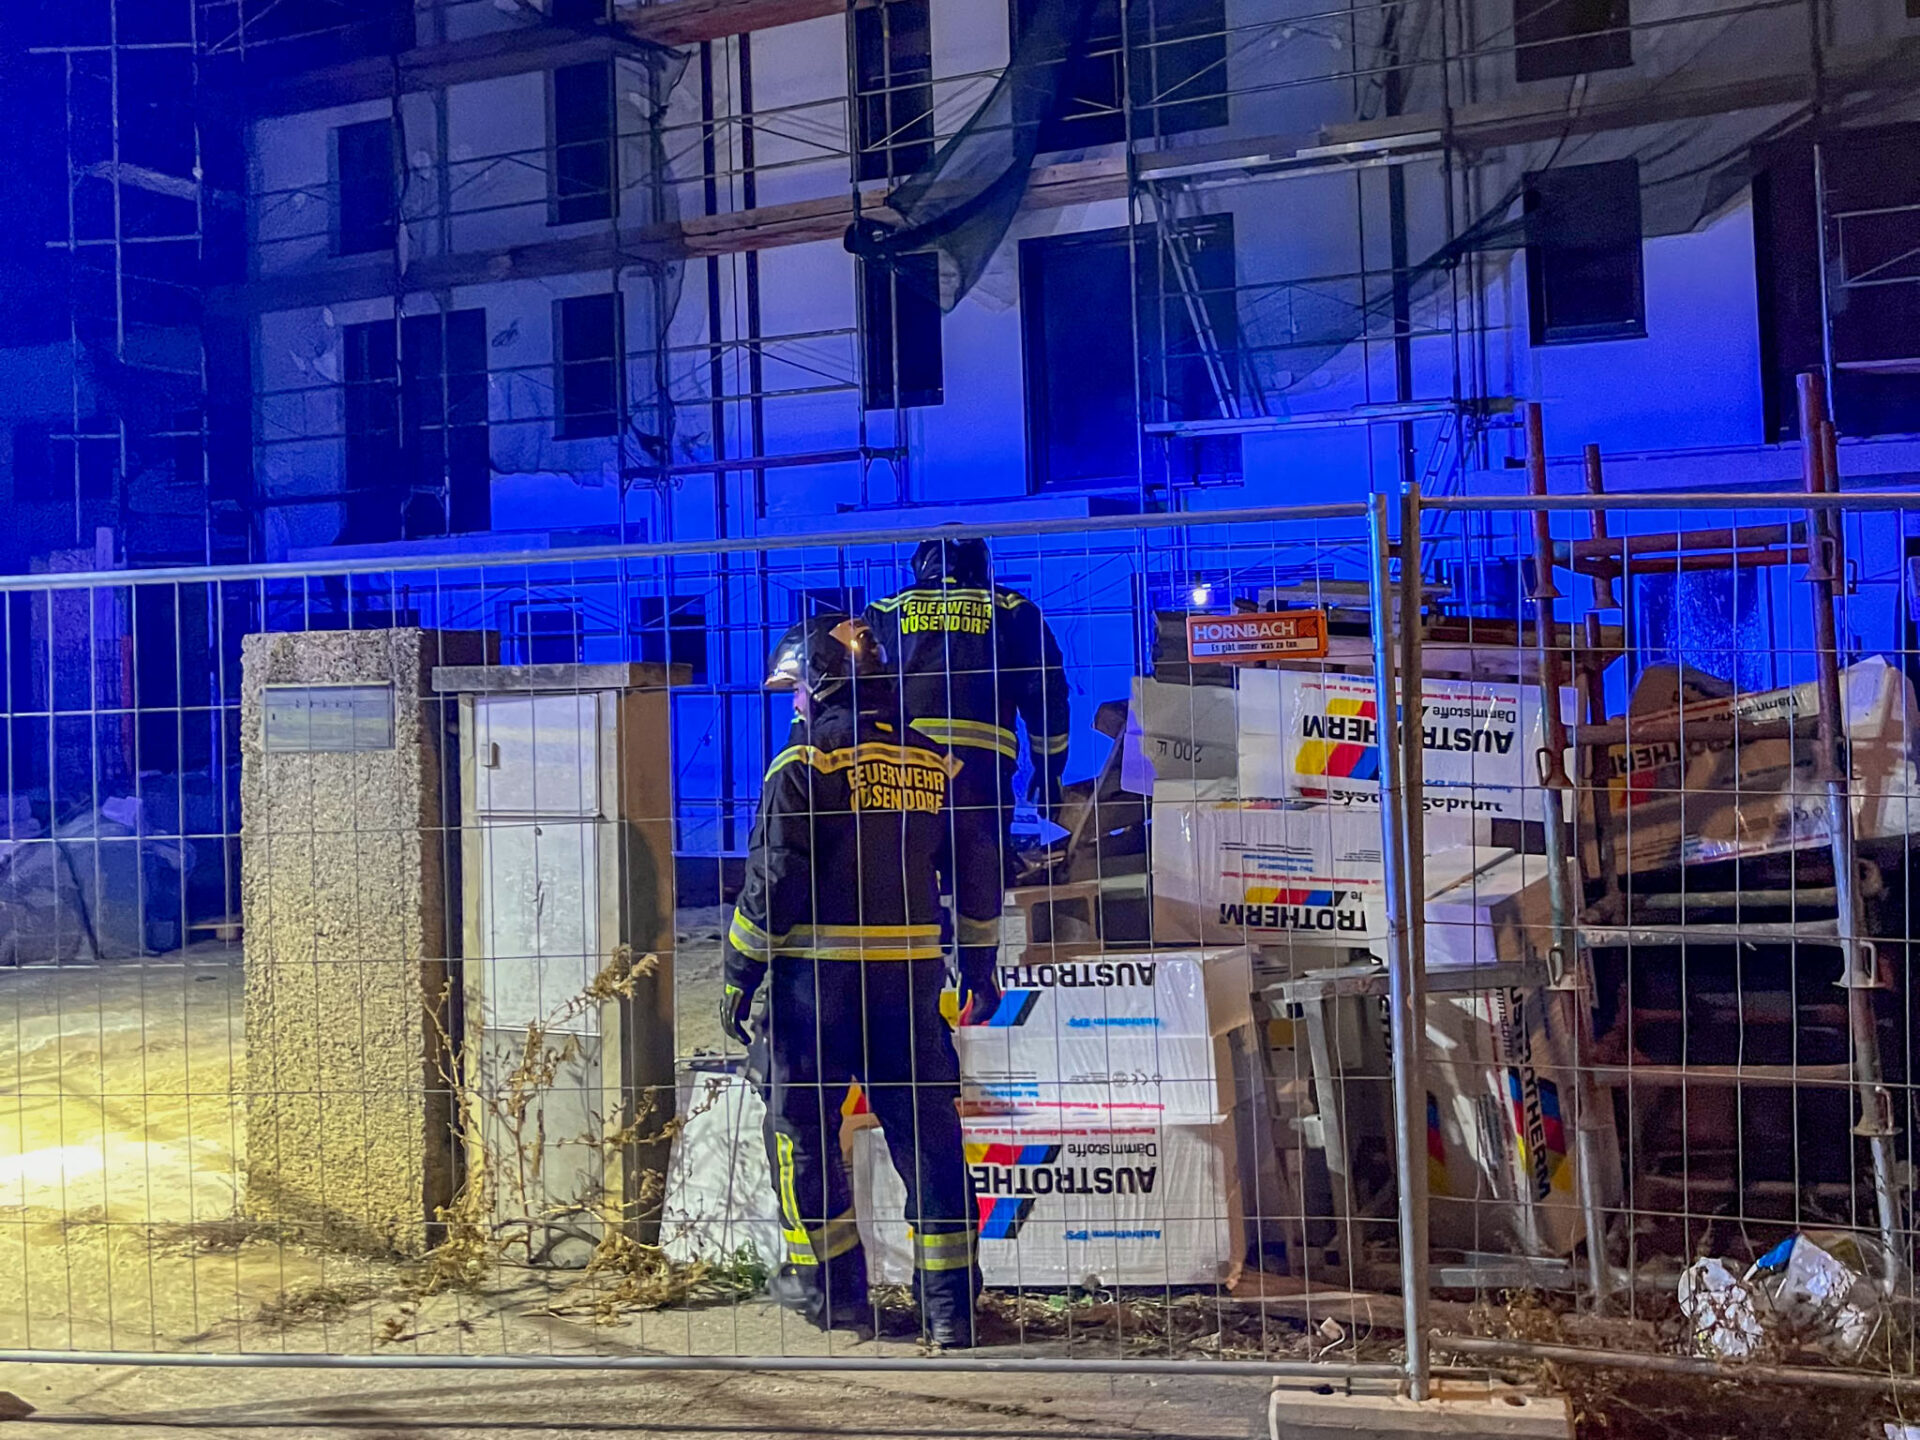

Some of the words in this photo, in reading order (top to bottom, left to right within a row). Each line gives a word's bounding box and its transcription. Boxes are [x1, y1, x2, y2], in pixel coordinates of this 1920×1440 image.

[1194, 621, 1295, 641] HORNBACH
[1433, 705, 1517, 724] Dämmstoffe
[1302, 714, 1515, 754] AUSTRHERM
[847, 763, 945, 792] FEUERWEHR
[1067, 1143, 1157, 1158] Dämmstoffe
